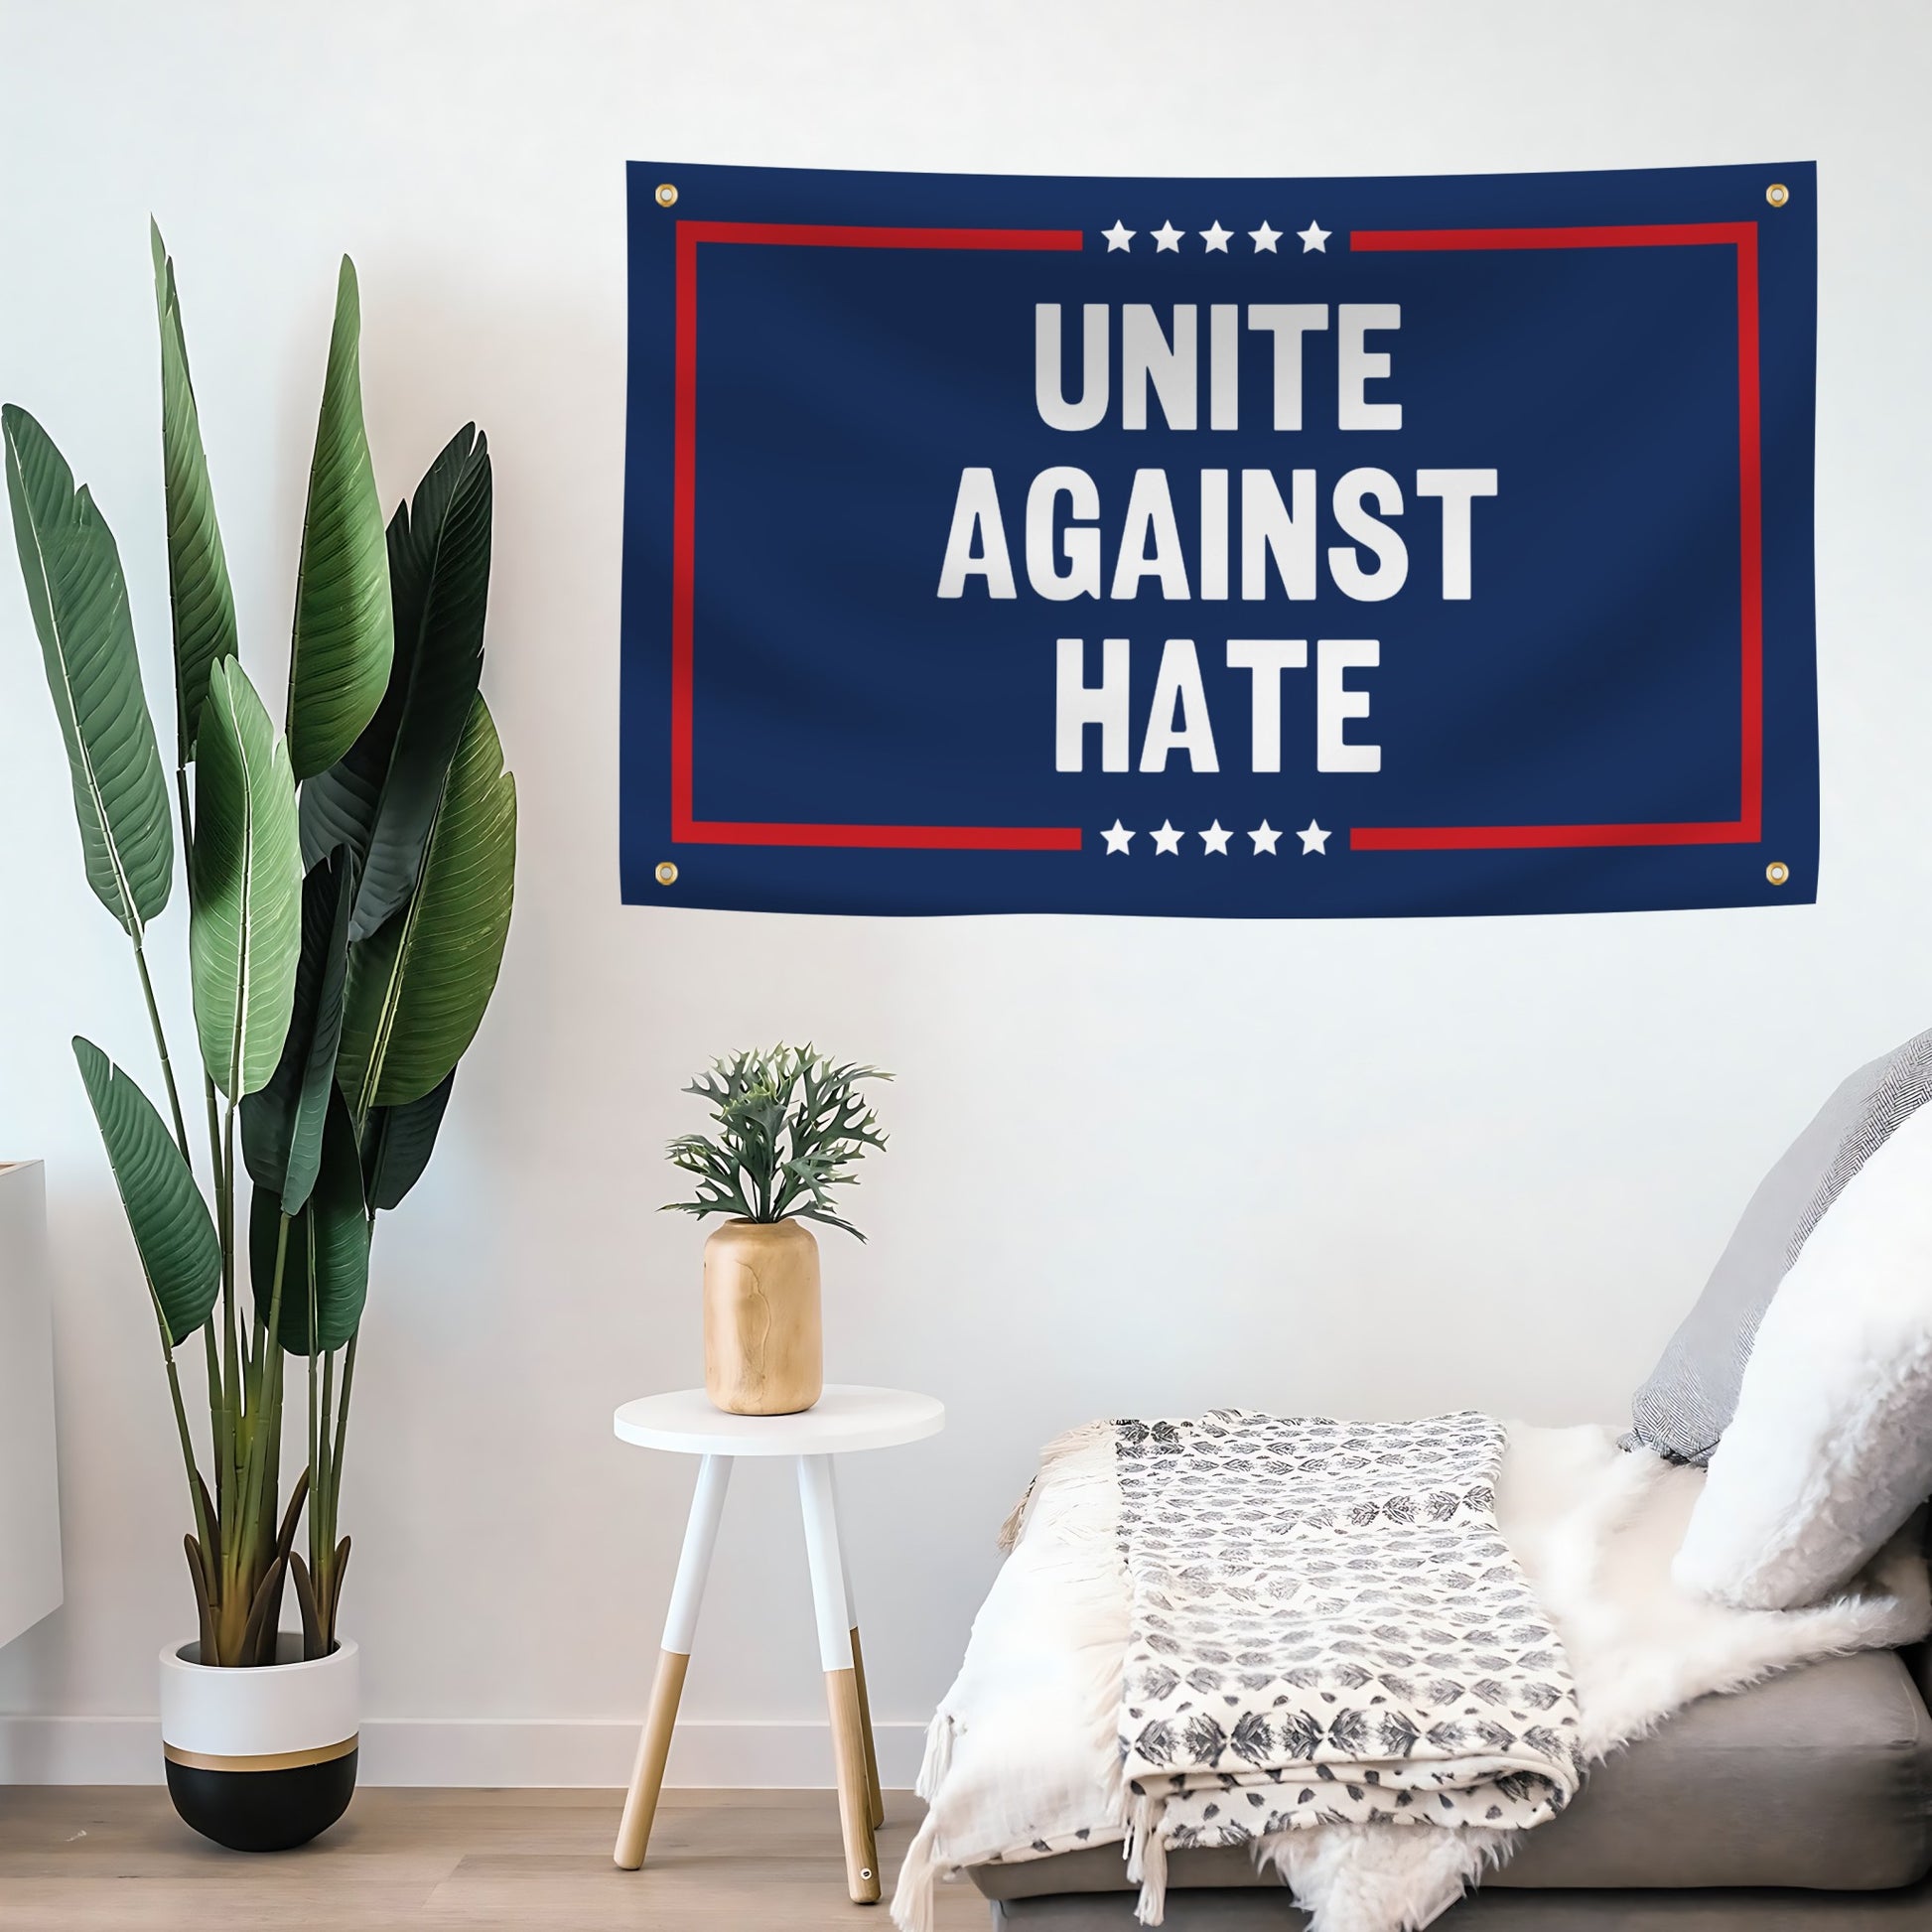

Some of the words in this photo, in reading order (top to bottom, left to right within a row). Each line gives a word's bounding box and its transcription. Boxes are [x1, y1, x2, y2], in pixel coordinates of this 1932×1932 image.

[1035, 303, 1403, 432] UNITE
[936, 466, 1498, 602] AGAINST
[1055, 638, 1383, 774] HATE
